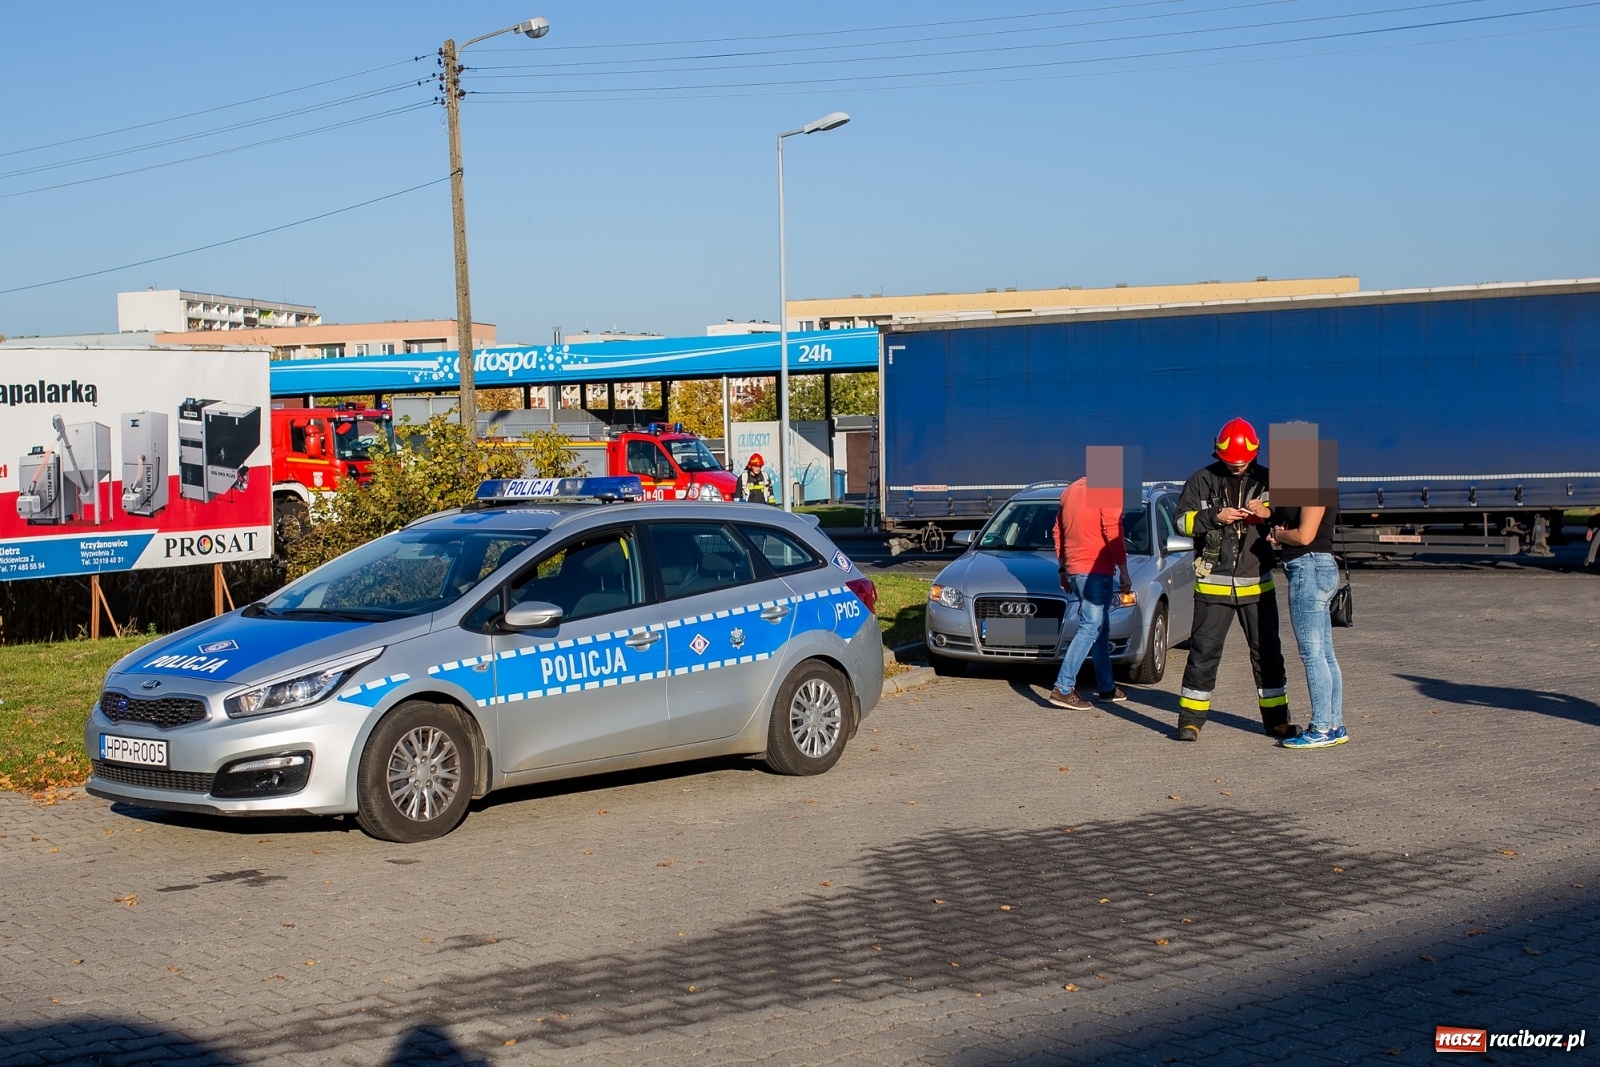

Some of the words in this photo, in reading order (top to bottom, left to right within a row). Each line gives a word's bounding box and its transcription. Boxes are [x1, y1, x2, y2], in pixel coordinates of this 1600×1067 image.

[798, 344, 832, 363] 24h
[737, 430, 770, 450] autospa
[506, 480, 554, 496] POLICJA
[80, 539, 128, 551] Krzyżanowice
[110, 548, 115, 556] 2
[164, 532, 258, 558] PROSAT
[835, 600, 860, 621] P105
[142, 655, 229, 673] POLICJA
[540, 646, 628, 685] POLICJA
